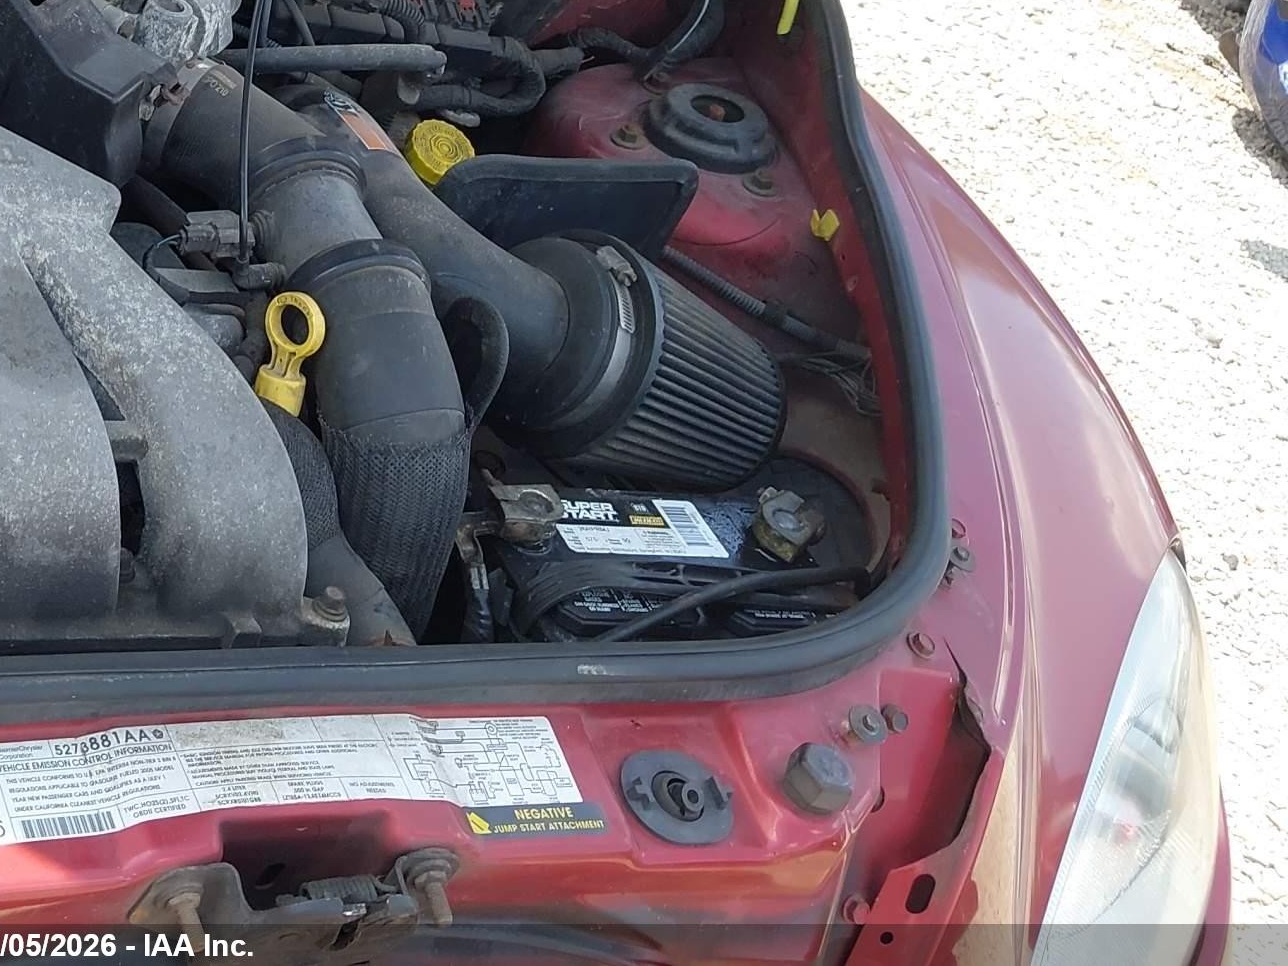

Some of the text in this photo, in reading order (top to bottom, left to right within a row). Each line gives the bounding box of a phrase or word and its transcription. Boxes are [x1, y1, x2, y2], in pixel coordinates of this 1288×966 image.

[560, 499, 614, 512] SUPER
[32, 759, 71, 769] EMISSION
[72, 752, 113, 767] CONTROL
[114, 743, 172, 756] INFORMATION
[514, 806, 574, 820] NEGATIVE
[494, 820, 605, 834] JUMP START ATTACHMENT
